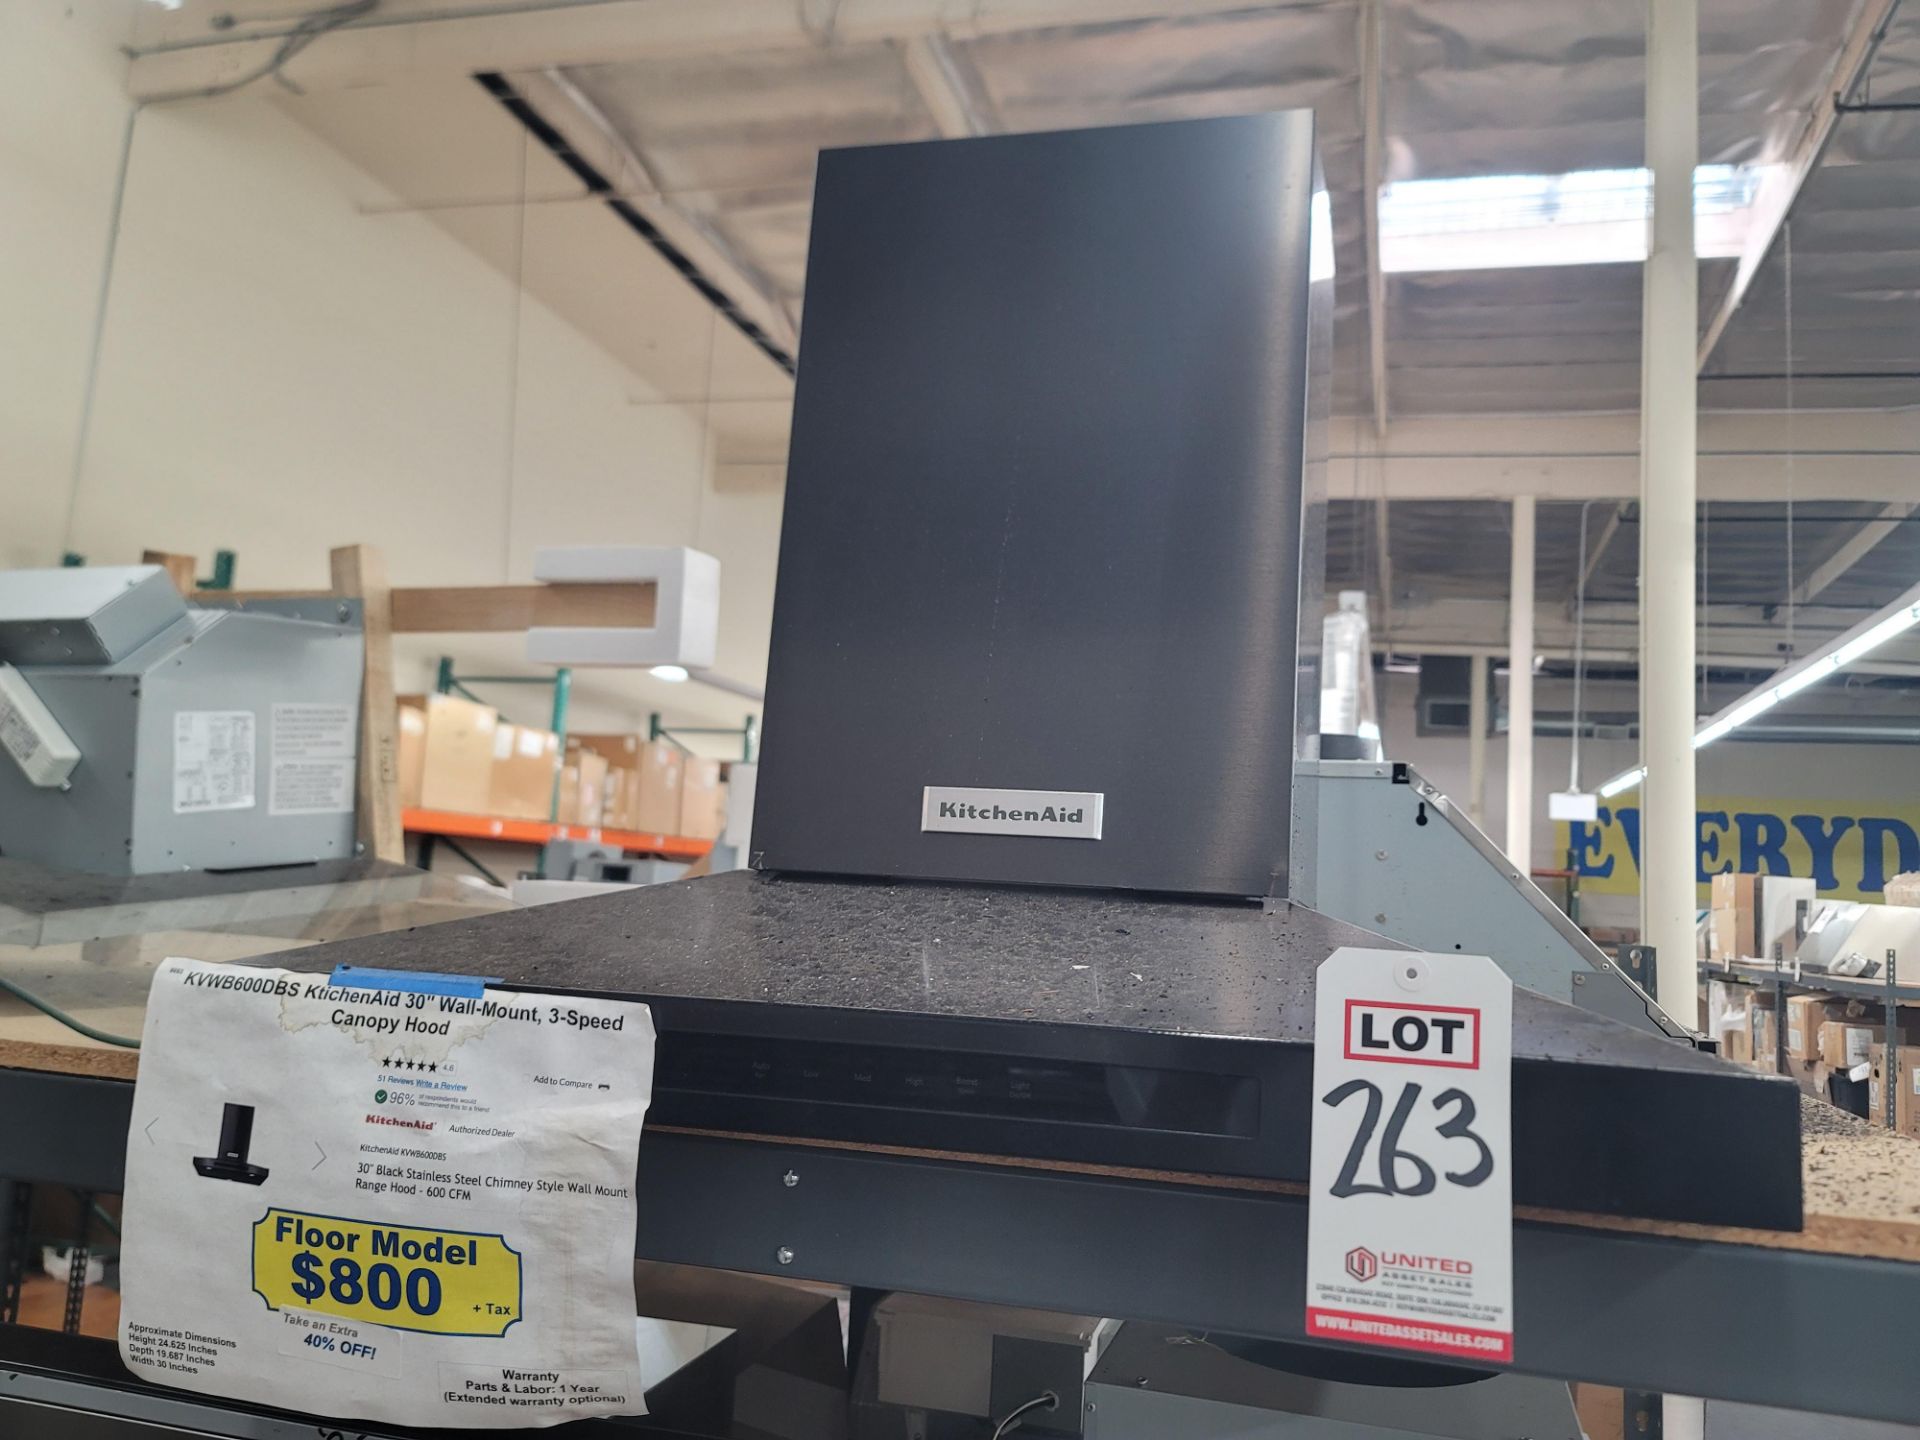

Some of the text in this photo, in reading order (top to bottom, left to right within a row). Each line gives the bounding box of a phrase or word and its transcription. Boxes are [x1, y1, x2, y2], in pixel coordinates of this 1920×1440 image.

[939, 801, 1083, 823] KitchenAid
[184, 970, 625, 1032] KVWB600DBS KtichenAid 30" Wall-Mount, 3-Speed
[331, 1009, 451, 1036] Canopy Hood
[1361, 1012, 1465, 1054] LOT
[388, 1075, 415, 1086] Reviews
[415, 1078, 433, 1088] Write
[440, 1082, 468, 1092] Review
[533, 1075, 593, 1089] Add to Compare
[389, 1091, 415, 1106] 96%
[365, 1114, 433, 1131] KitchenAid
[449, 1124, 515, 1138] Authorized Dealer
[1322, 1078, 1495, 1199] 263
[360, 1143, 447, 1161] KitchenAid KVWB600DBS
[355, 1178, 388, 1192] Range
[390, 1181, 416, 1195] Hood
[426, 1185, 446, 1198] 600
[448, 1188, 472, 1201] CFM
[357, 1162, 629, 1199] 30" Black Stainless Steel Chimney Style Wall Mount
[275, 1216, 477, 1266] Floor Model
[1381, 1251, 1473, 1275] UNITED
[291, 1250, 442, 1317] $800
[472, 1302, 512, 1316] + Tax
[128, 1321, 237, 1348] Approximate Dimensions
[283, 1312, 359, 1338] Take an Extra
[1315, 1314, 1504, 1353] WWW.UNITEDASSETSALES.COM
[128, 1332, 218, 1356] Height 24.625 Inches
[129, 1343, 216, 1367] Depth 19.687 Inches
[303, 1333, 377, 1360] 40% OFF!
[129, 1353, 199, 1374] Width 30 Inches
[502, 1368, 560, 1383] Warranty
[443, 1391, 626, 1407] (Extended warranty optional)
[465, 1380, 600, 1394] Parts & Labor: 1 Year
